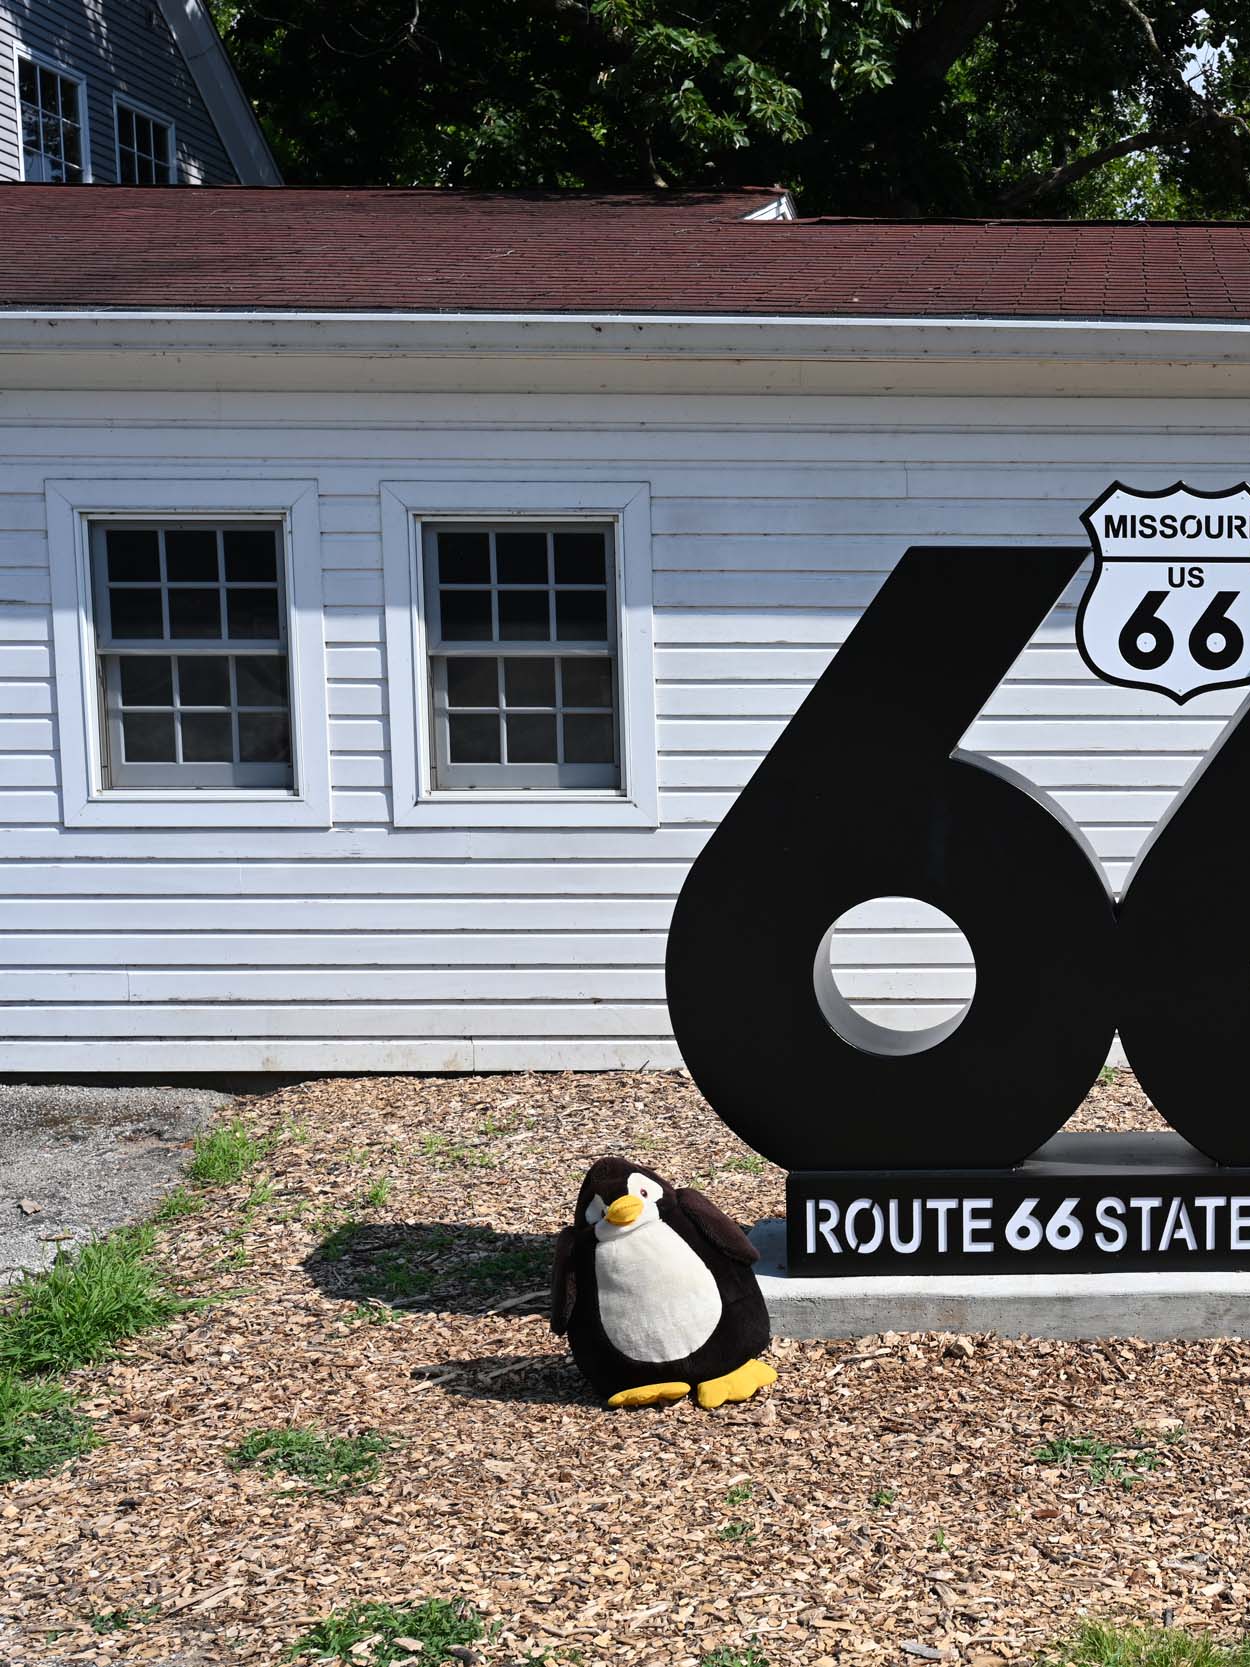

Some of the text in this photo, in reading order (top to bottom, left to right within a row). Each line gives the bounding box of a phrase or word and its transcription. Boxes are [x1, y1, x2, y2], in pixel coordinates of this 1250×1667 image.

[1168, 566, 1205, 589] US
[1118, 590, 1244, 671] 66
[805, 1198, 995, 1254] ROUTE
[1004, 1197, 1084, 1251] 66
